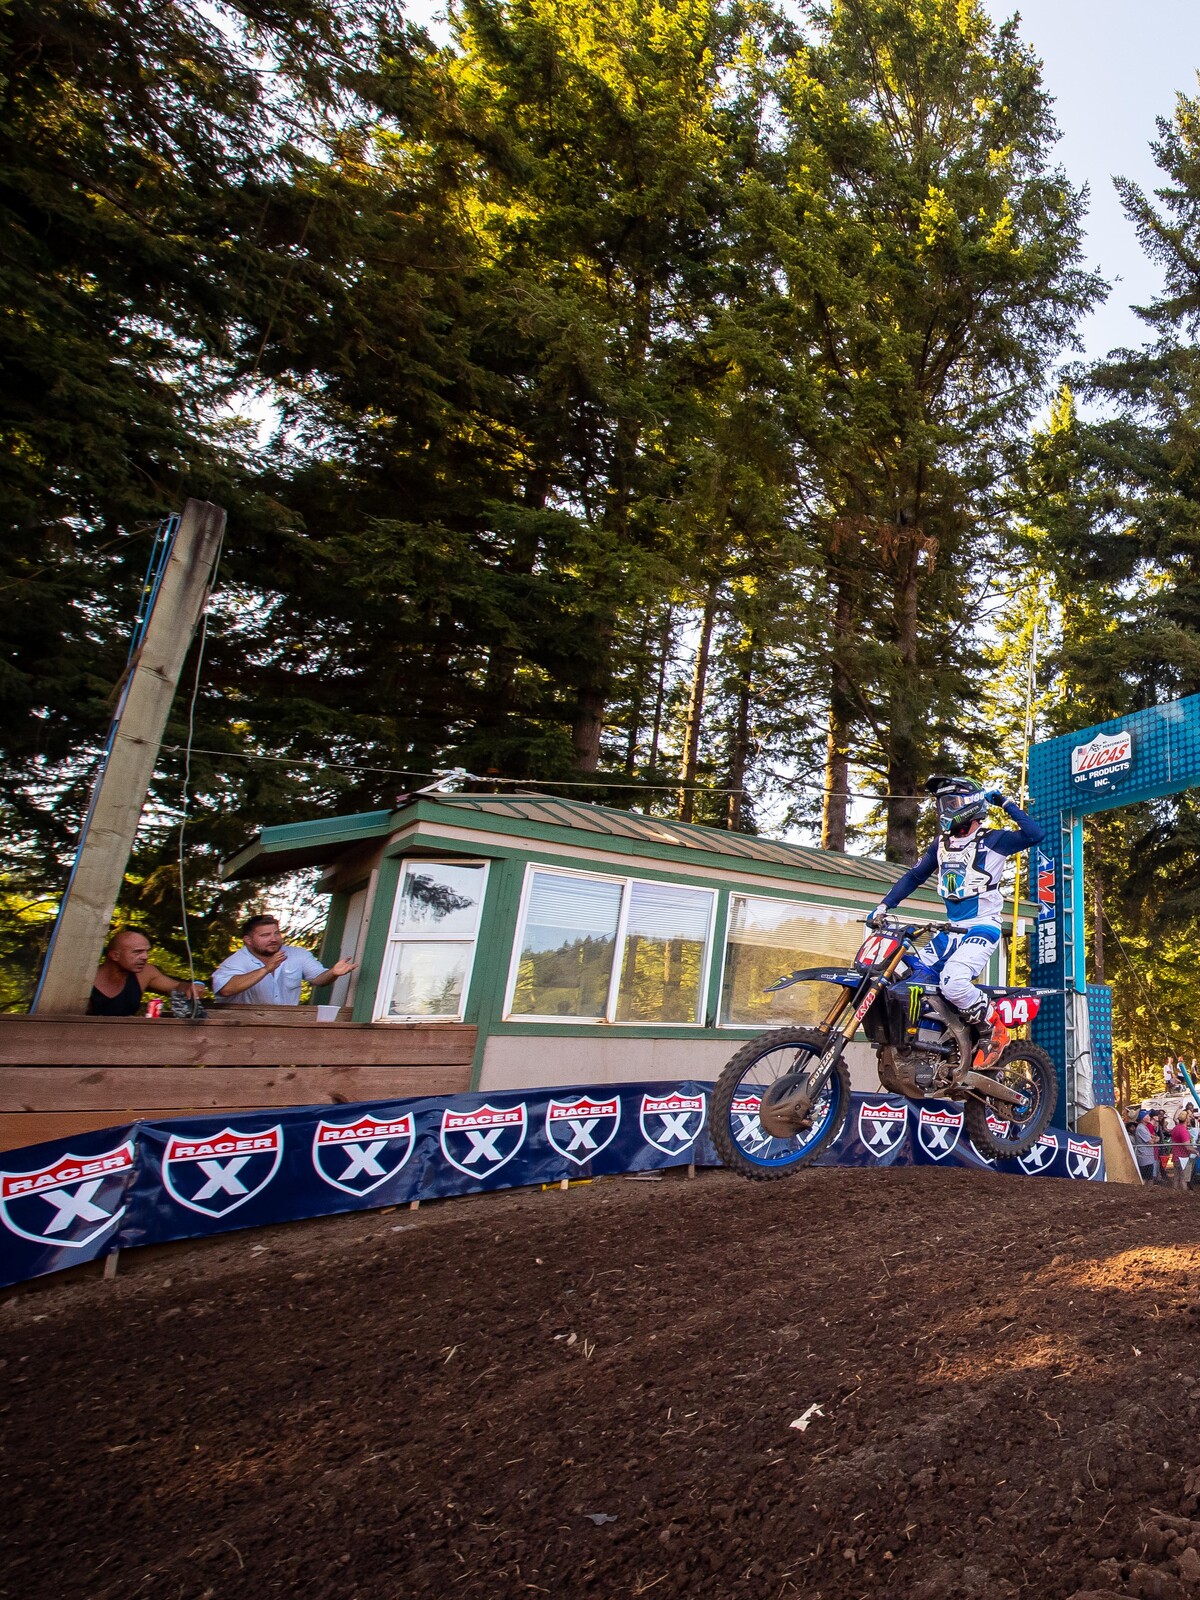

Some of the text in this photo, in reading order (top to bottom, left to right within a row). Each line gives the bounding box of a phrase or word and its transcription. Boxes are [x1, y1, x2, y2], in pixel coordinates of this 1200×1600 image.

[1078, 743, 1129, 772] LUCAS
[1074, 762, 1131, 783] OIL PRODUCTS
[1094, 778, 1110, 788] INC.
[1037, 846, 1056, 922] AMA
[859, 936, 894, 965] 14
[1038, 923, 1046, 965] RACING
[1045, 921, 1057, 965] PRO
[855, 991, 876, 1022] KYB
[999, 1000, 1029, 1024] 14
[809, 1046, 836, 1087] DUNLOP
[552, 1104, 615, 1118] RACER
[644, 1099, 701, 1110] RACER
[863, 1109, 904, 1118] RACER
[322, 1122, 406, 1141] RACER
[448, 1111, 519, 1127] RACER
[656, 1112, 692, 1143] X
[922, 1114, 960, 1125] RACER
[565, 1118, 600, 1151] X
[868, 1120, 894, 1145] X
[926, 1125, 950, 1149] X
[174, 1136, 274, 1158] RACER
[461, 1127, 505, 1165] X
[1022, 1143, 1048, 1167] X
[1070, 1144, 1099, 1157] RACER
[336, 1140, 389, 1181] X
[1072, 1154, 1092, 1178] X
[8, 1154, 126, 1193] RACER
[191, 1155, 253, 1201] X
[39, 1178, 112, 1235] X
